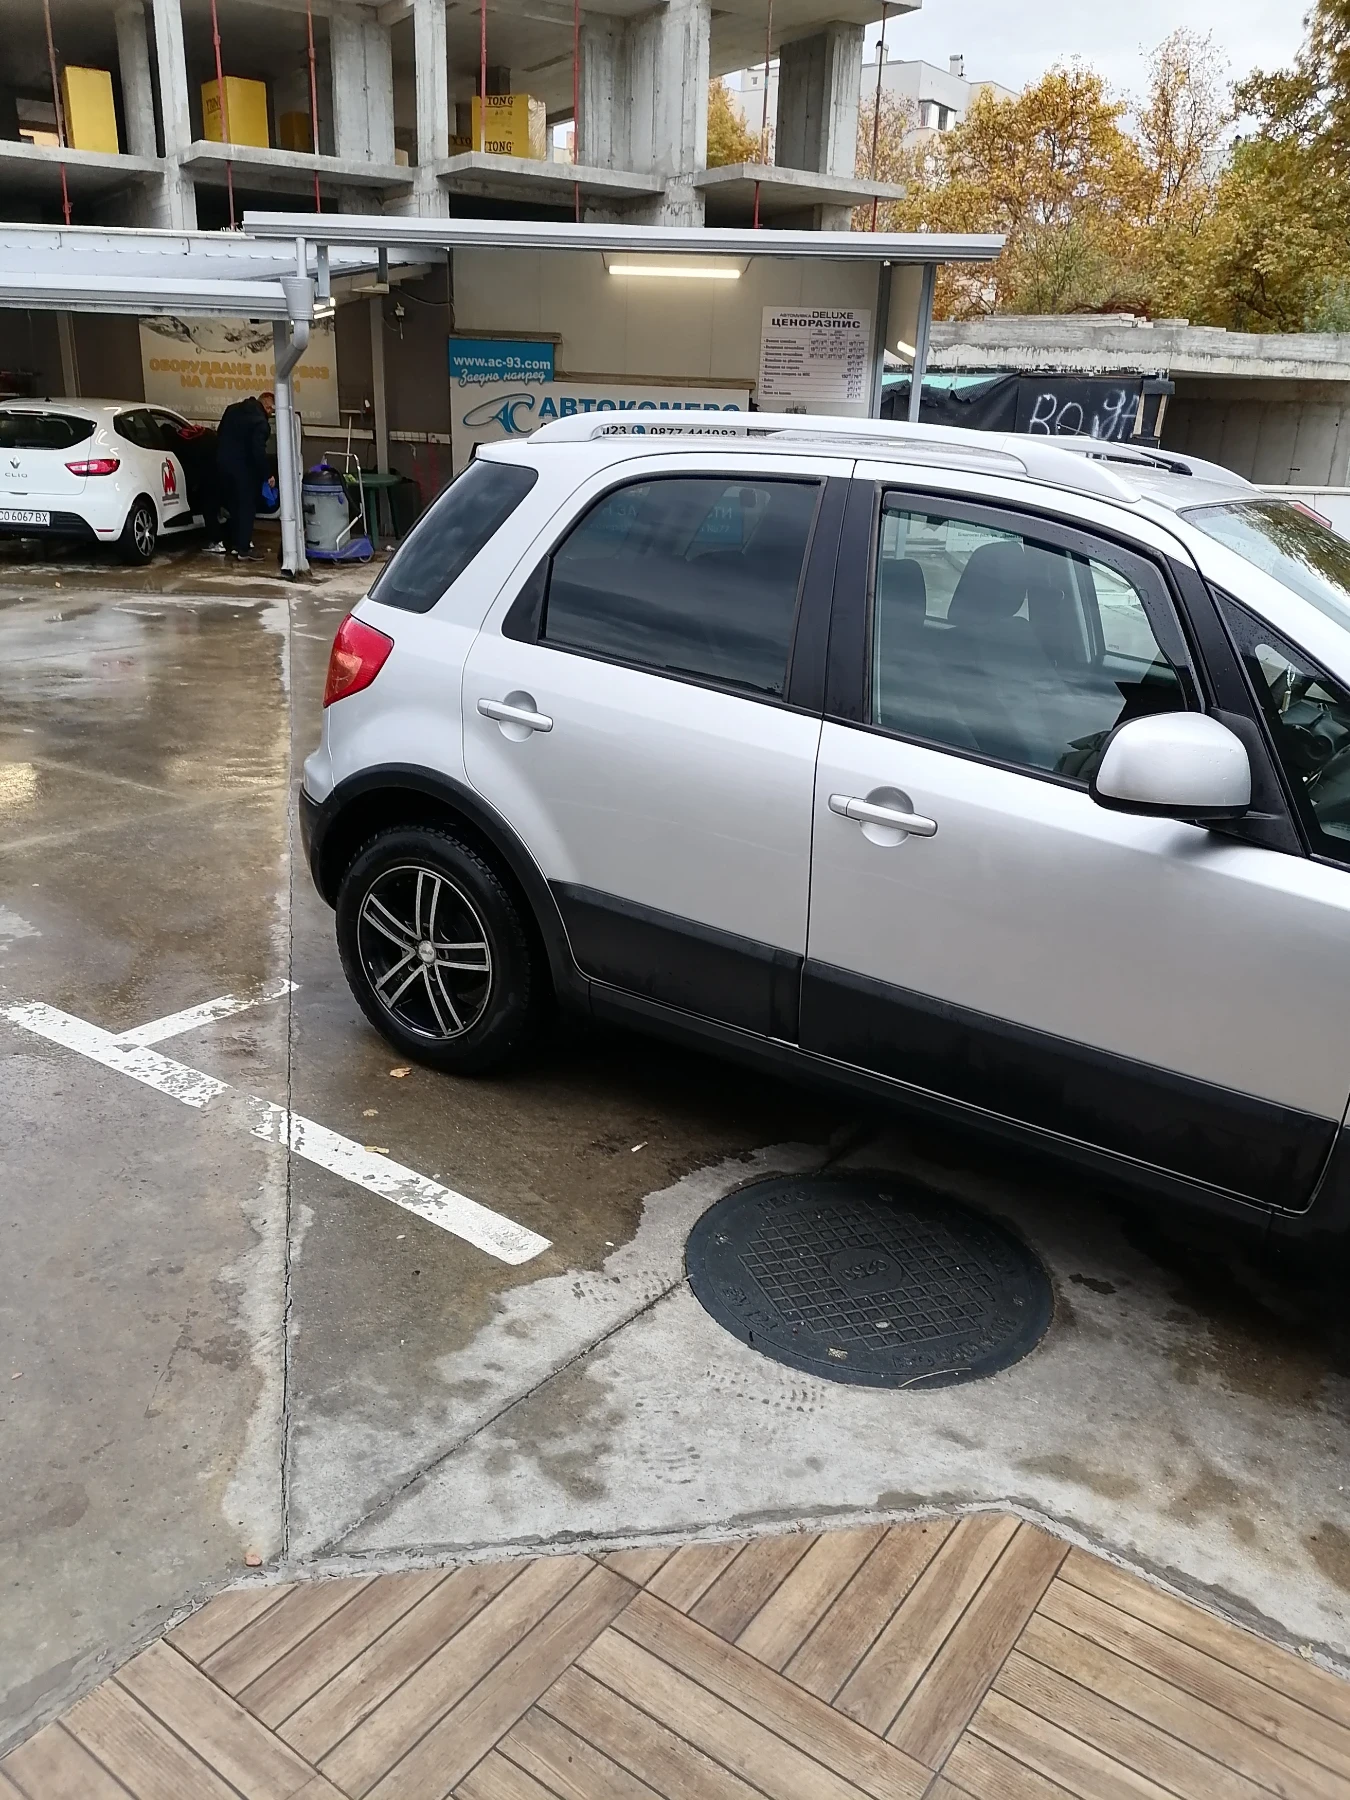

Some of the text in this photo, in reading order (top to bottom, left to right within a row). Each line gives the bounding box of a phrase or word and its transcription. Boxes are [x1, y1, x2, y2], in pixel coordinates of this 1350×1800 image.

[482, 96, 514, 106] TONG
[484, 140, 513, 152] TONG
[812, 310, 854, 320] DELUXE
[771, 318, 861, 329] ЦЕНОРАЗПИС
[149, 358, 253, 376] ОБОРУДВАНЕ
[256, 362, 267, 376] И
[453, 356, 551, 370] www.ac-93.com
[180, 374, 203, 388] НА
[459, 368, 546, 387] Заедно напред
[11, 511, 34, 522] 6067
[35, 512, 48, 523] BX
